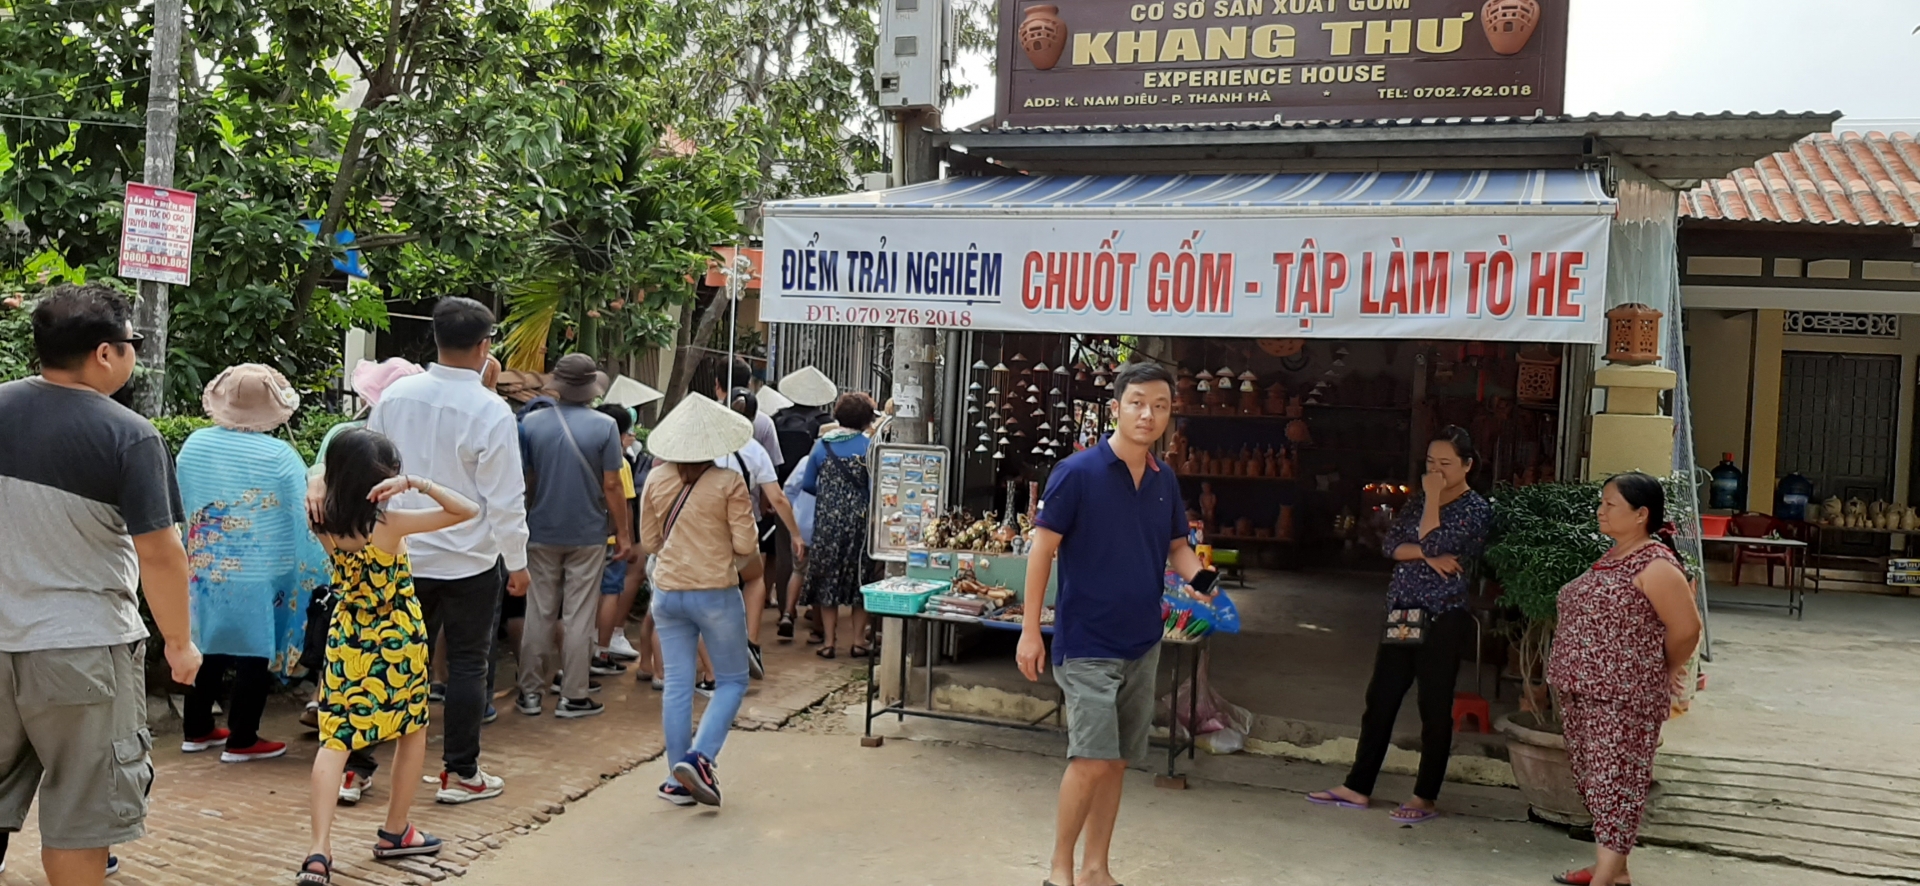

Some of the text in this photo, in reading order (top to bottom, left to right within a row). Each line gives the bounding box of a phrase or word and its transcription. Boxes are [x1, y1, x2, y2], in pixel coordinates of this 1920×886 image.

[1131, 1, 1165, 21] CƠ
[1072, 12, 1474, 66] KHANG THƯ
[1143, 65, 1386, 88] EXPERIENCE HOUSE
[1023, 97, 1060, 108] ADD:
[1064, 96, 1078, 106] K.
[1083, 95, 1119, 106] NAM
[1171, 94, 1184, 104] P.
[1188, 92, 1243, 104] THANH
[1247, 90, 1272, 102] HÀ
[1377, 85, 1532, 99] TEL: 0702.762.018
[781, 232, 1003, 306] ĐIỂM TRẢI NGHIỆM
[1021, 230, 1138, 312] CHUỐT
[1146, 230, 1234, 313] GỐM
[1272, 237, 1349, 329] TẬP
[1359, 236, 1450, 315] LÀM
[1463, 234, 1515, 317] TÒ
[1525, 251, 1584, 317] HE
[806, 305, 972, 327] ĐT: 070 276 2018
